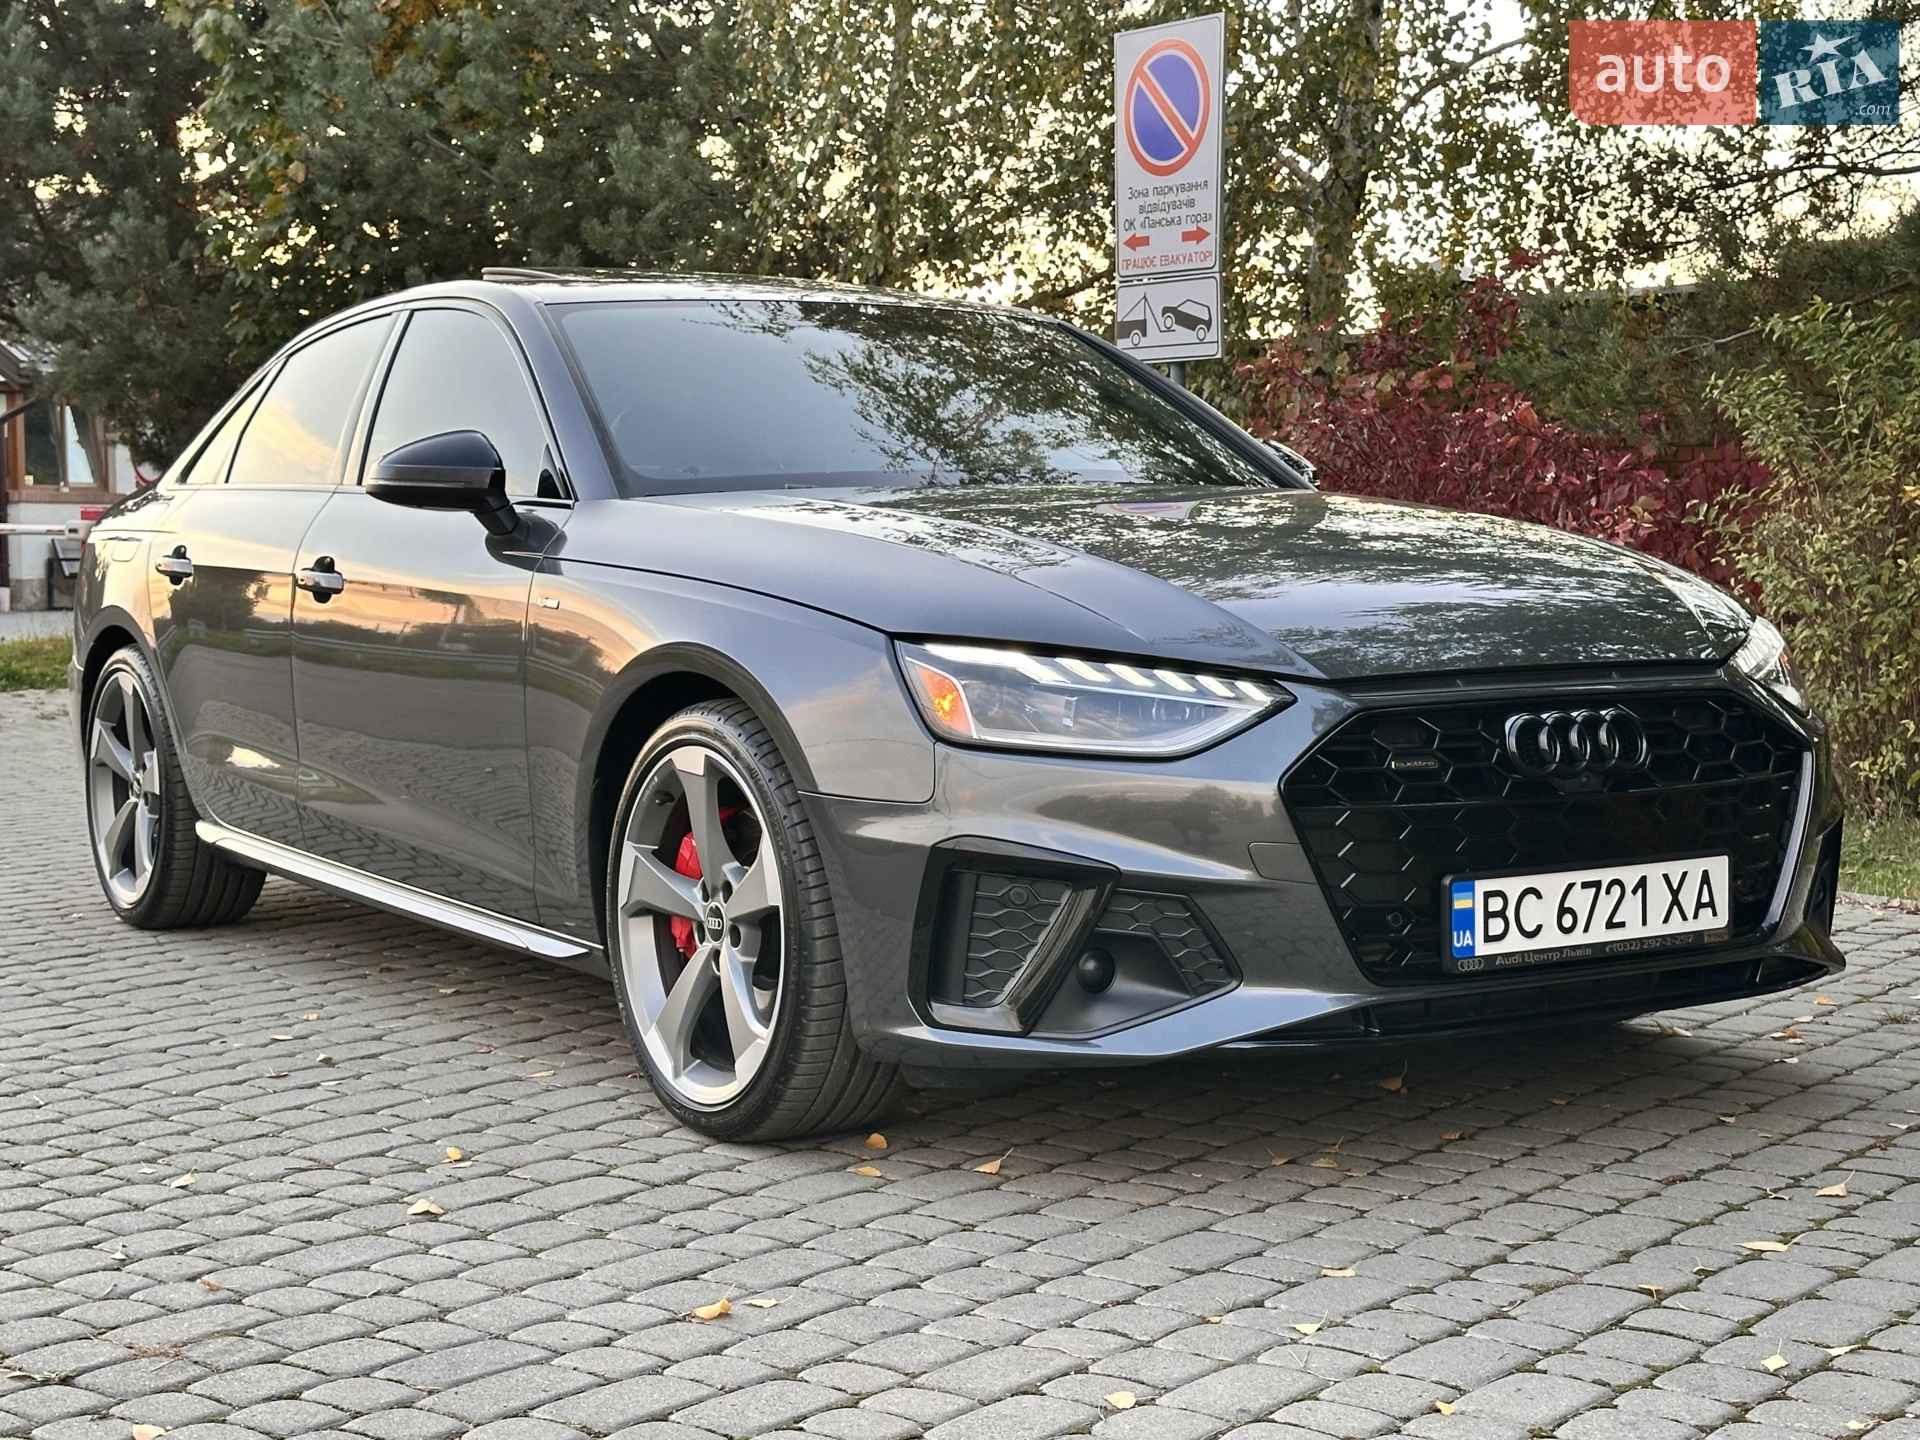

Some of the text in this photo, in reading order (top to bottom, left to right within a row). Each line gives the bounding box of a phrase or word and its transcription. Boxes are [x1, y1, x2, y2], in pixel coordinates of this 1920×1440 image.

[1127, 180, 1208, 200] Зона паркування
[1138, 195, 1196, 215] відвідувачів
[1123, 218, 1136, 232] ОК
[1121, 250, 1213, 271] ПРАЦЮЄ ЕВАКУАТОР!
[1482, 868, 1718, 943] BC 6721 XA
[1453, 930, 1473, 947] UA
[1495, 934, 1694, 966] Audi Центр Львів (032) 297-1-297
